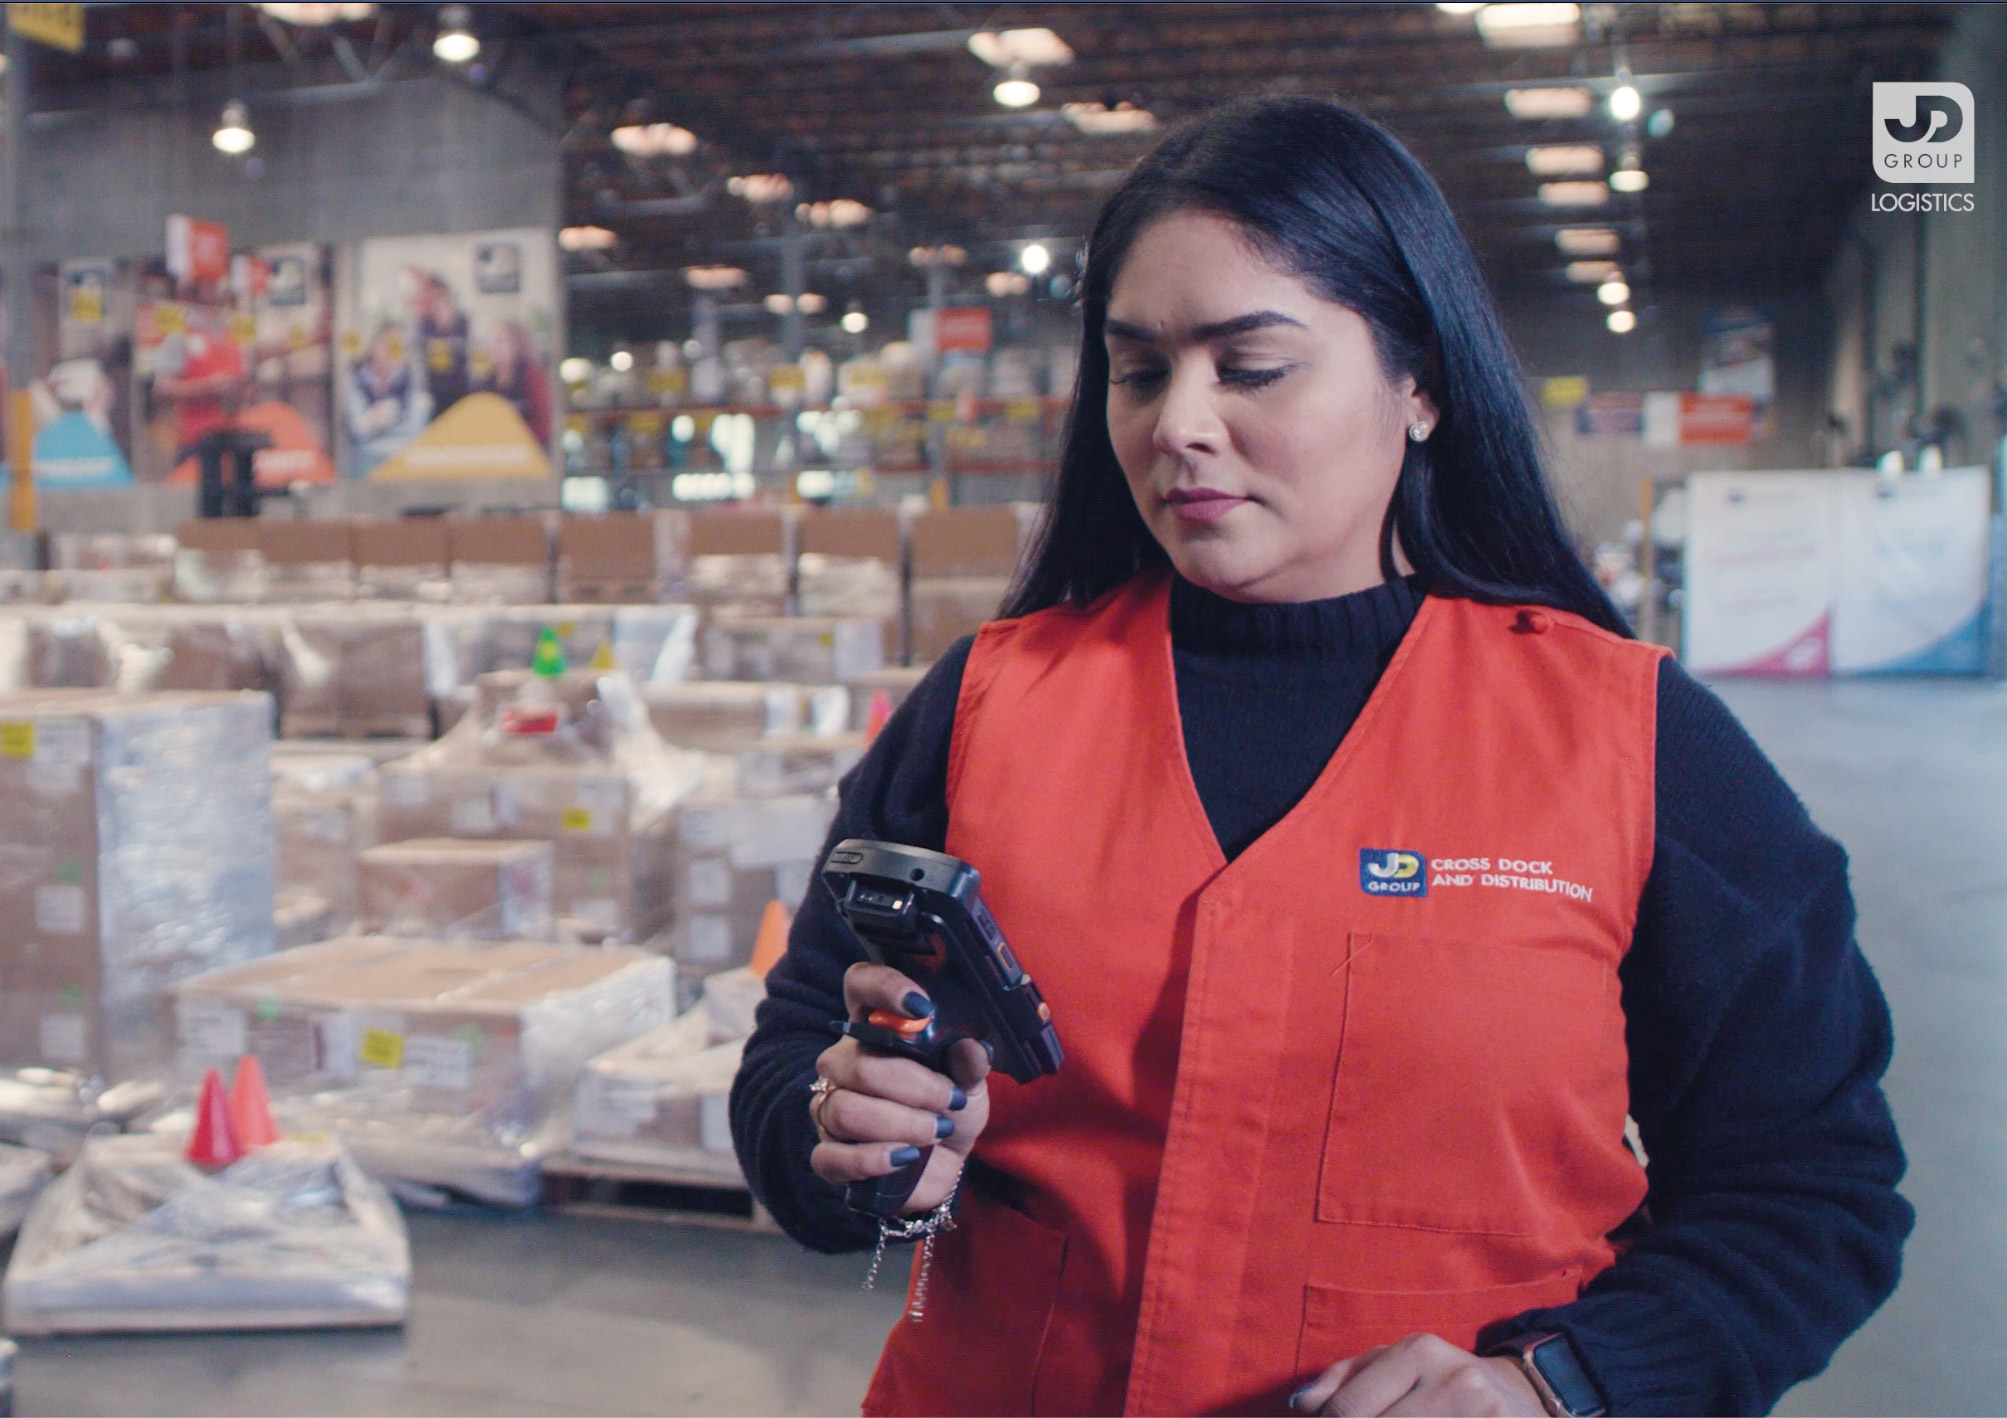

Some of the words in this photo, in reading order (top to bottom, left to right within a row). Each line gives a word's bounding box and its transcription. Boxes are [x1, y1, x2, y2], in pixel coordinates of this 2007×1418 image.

[1368, 852, 1420, 878] JD
[1431, 857, 1491, 871] CROSS
[1498, 858, 1553, 874] DOCK
[1368, 881, 1420, 892] GROUP
[1431, 874, 1474, 887] AND
[1480, 874, 1593, 902] DISTRIBUTION
